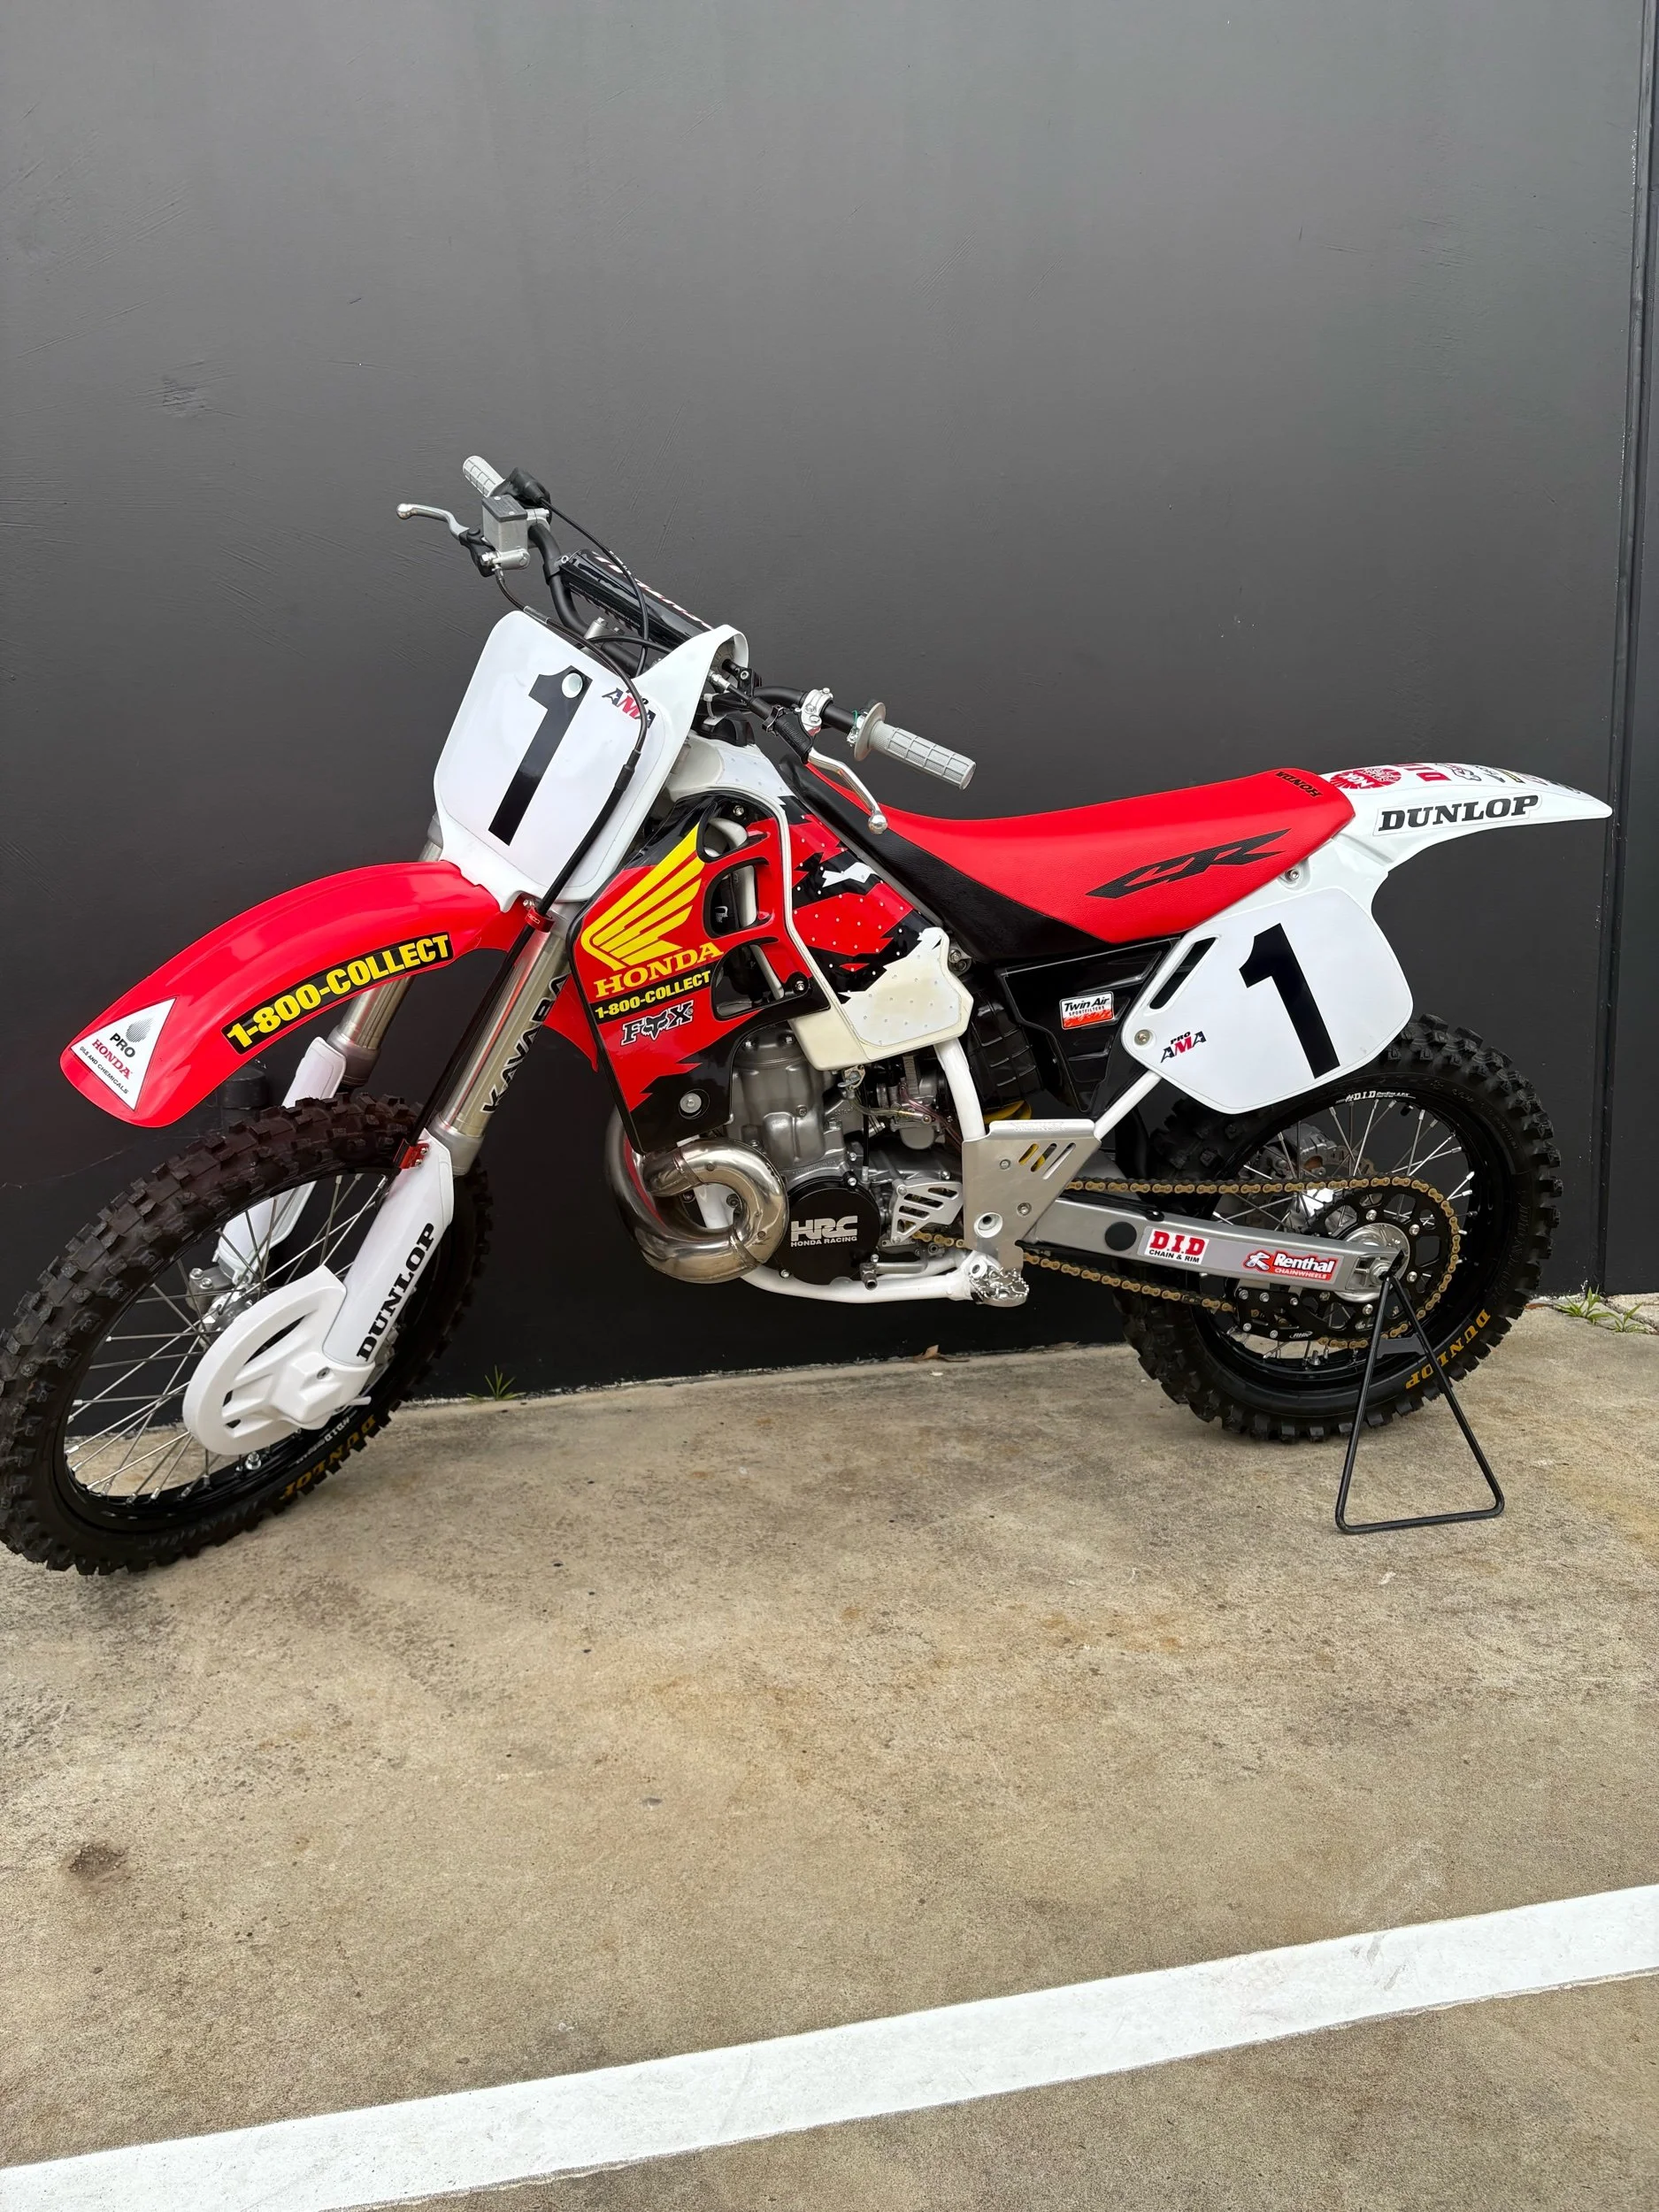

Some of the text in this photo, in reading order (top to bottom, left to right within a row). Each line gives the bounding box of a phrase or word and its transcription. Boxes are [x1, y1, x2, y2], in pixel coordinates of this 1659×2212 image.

[488, 664, 594, 847] 1
[1274, 771, 1324, 797] HONDA
[1378, 795, 1539, 832] DUNLOP
[594, 941, 724, 998] HONDA
[227, 934, 449, 1048] 1-800-COLLECT
[595, 971, 710, 1018] 1-800-COLLECT
[1064, 996, 1110, 1012] Twin Air
[1239, 923, 1340, 1079] 1
[1068, 1005, 1105, 1017] SPORTFILTERS
[109, 1032, 136, 1058] PRO
[1160, 1030, 1207, 1064] AMA
[1170, 1031, 1191, 1045] PRO
[80, 1046, 129, 1094] OILS AND CHEMICALS
[91, 1039, 132, 1080] HONDA
[790, 1215, 858, 1242] HRC
[790, 1235, 858, 1248] HONDA RACING
[1148, 1248, 1174, 1260] CHAIN
[1184, 1255, 1200, 1263] RIM
[1274, 1252, 1336, 1273] Renthal
[1274, 1267, 1327, 1279] CHAINWHEELS
[356, 1223, 434, 1362] DUNLOP
[1405, 1309, 1491, 1389] DUNLOP
